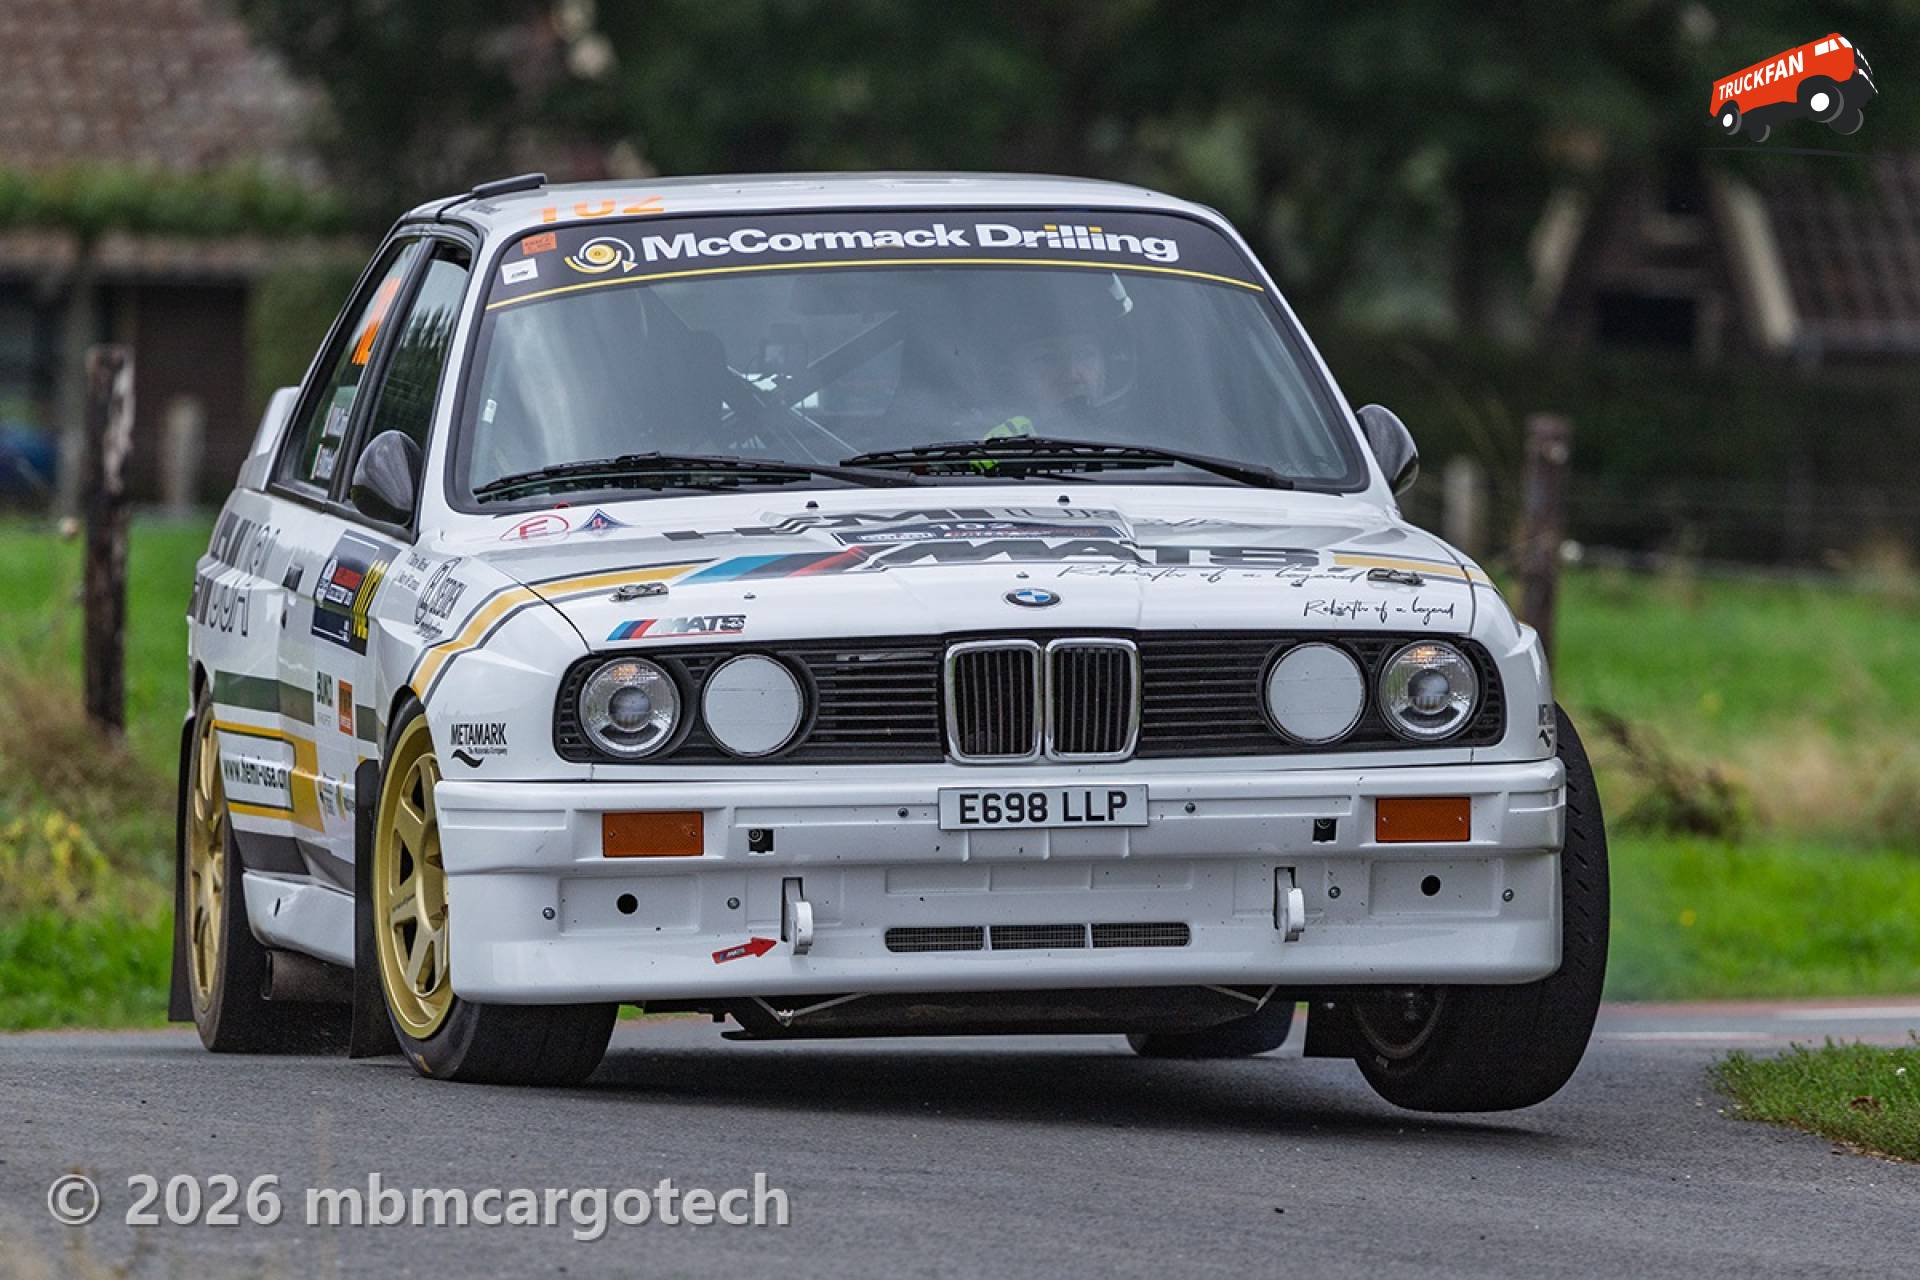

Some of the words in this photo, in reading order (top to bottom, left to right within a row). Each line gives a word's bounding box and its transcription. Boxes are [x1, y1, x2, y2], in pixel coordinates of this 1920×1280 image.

[642, 224, 971, 262] McCormack
[974, 223, 1180, 262] Drilling
[1303, 599, 1369, 620] Rebirth
[1375, 600, 1388, 624] of
[450, 723, 507, 745] METAMARK
[959, 791, 1048, 825] E698
[1062, 790, 1128, 822] LLP
